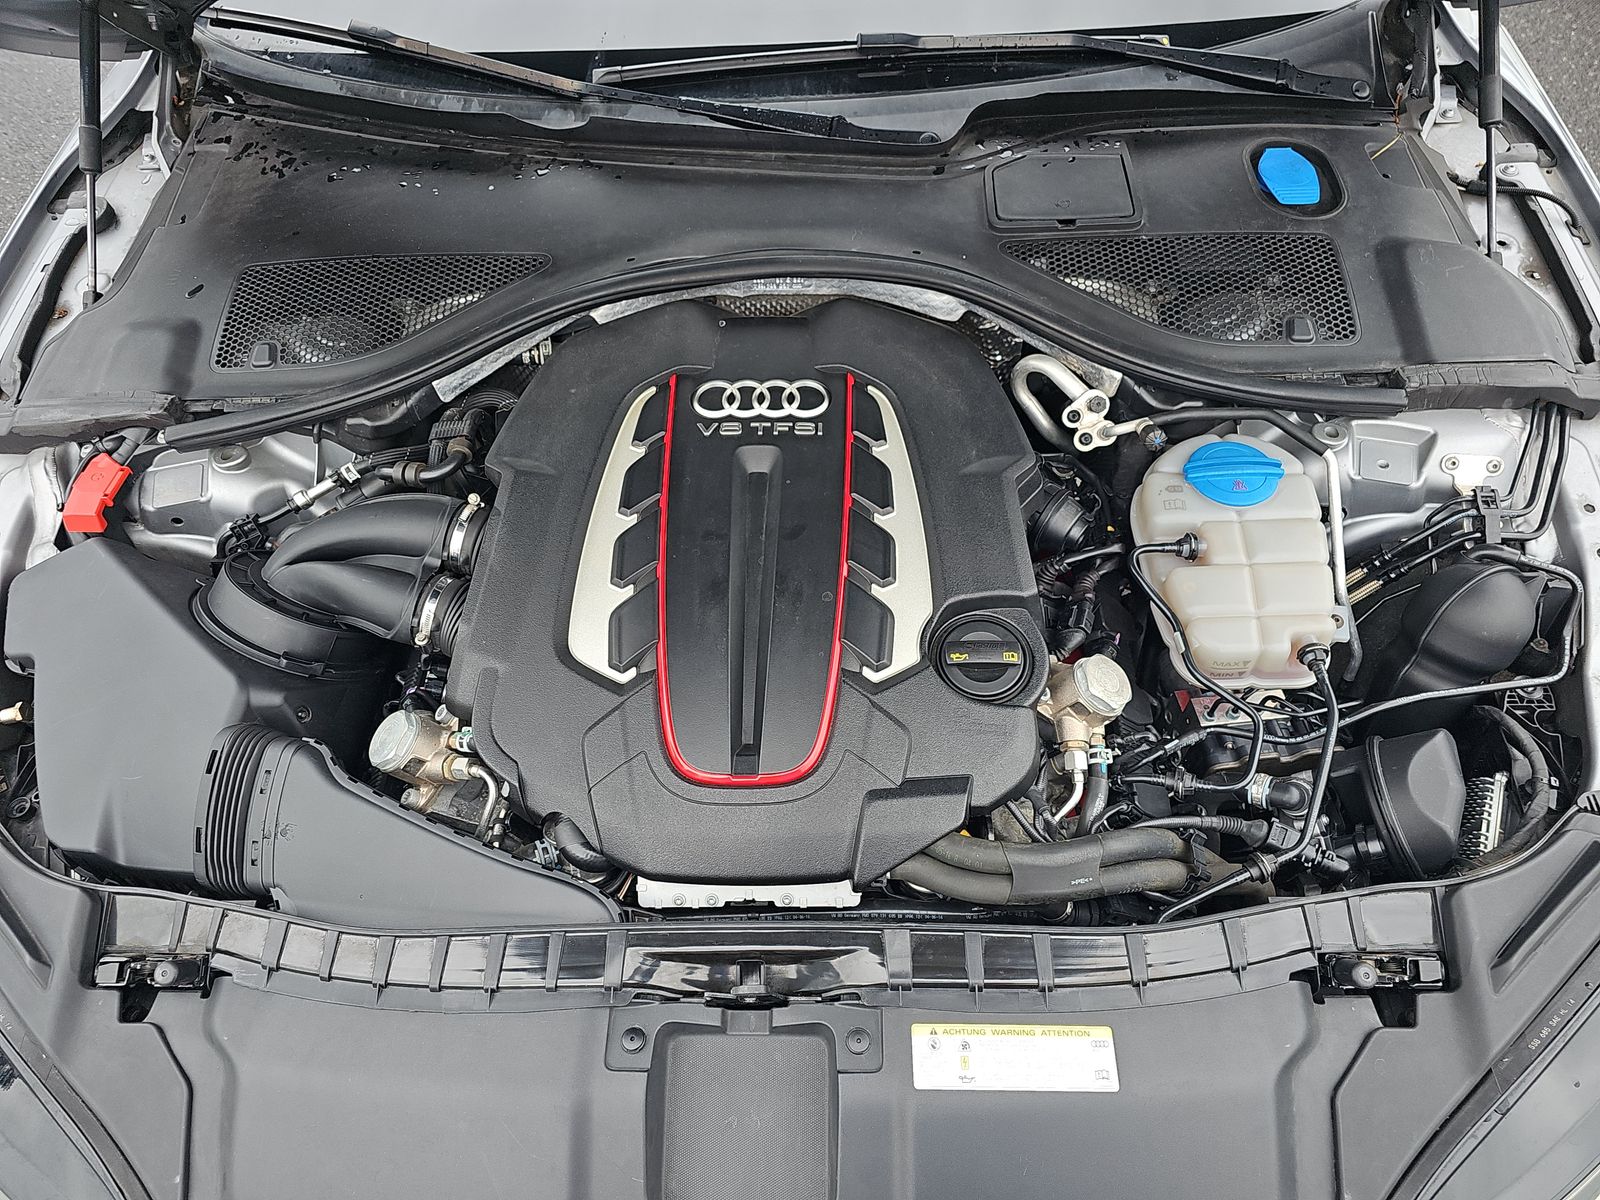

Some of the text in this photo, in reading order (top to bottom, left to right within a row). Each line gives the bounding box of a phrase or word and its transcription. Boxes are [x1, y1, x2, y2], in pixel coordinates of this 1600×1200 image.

[696, 421, 823, 436] V8 TFSI
[942, 1028, 1091, 1038] ACHTUNG WARNING ATTENTION
